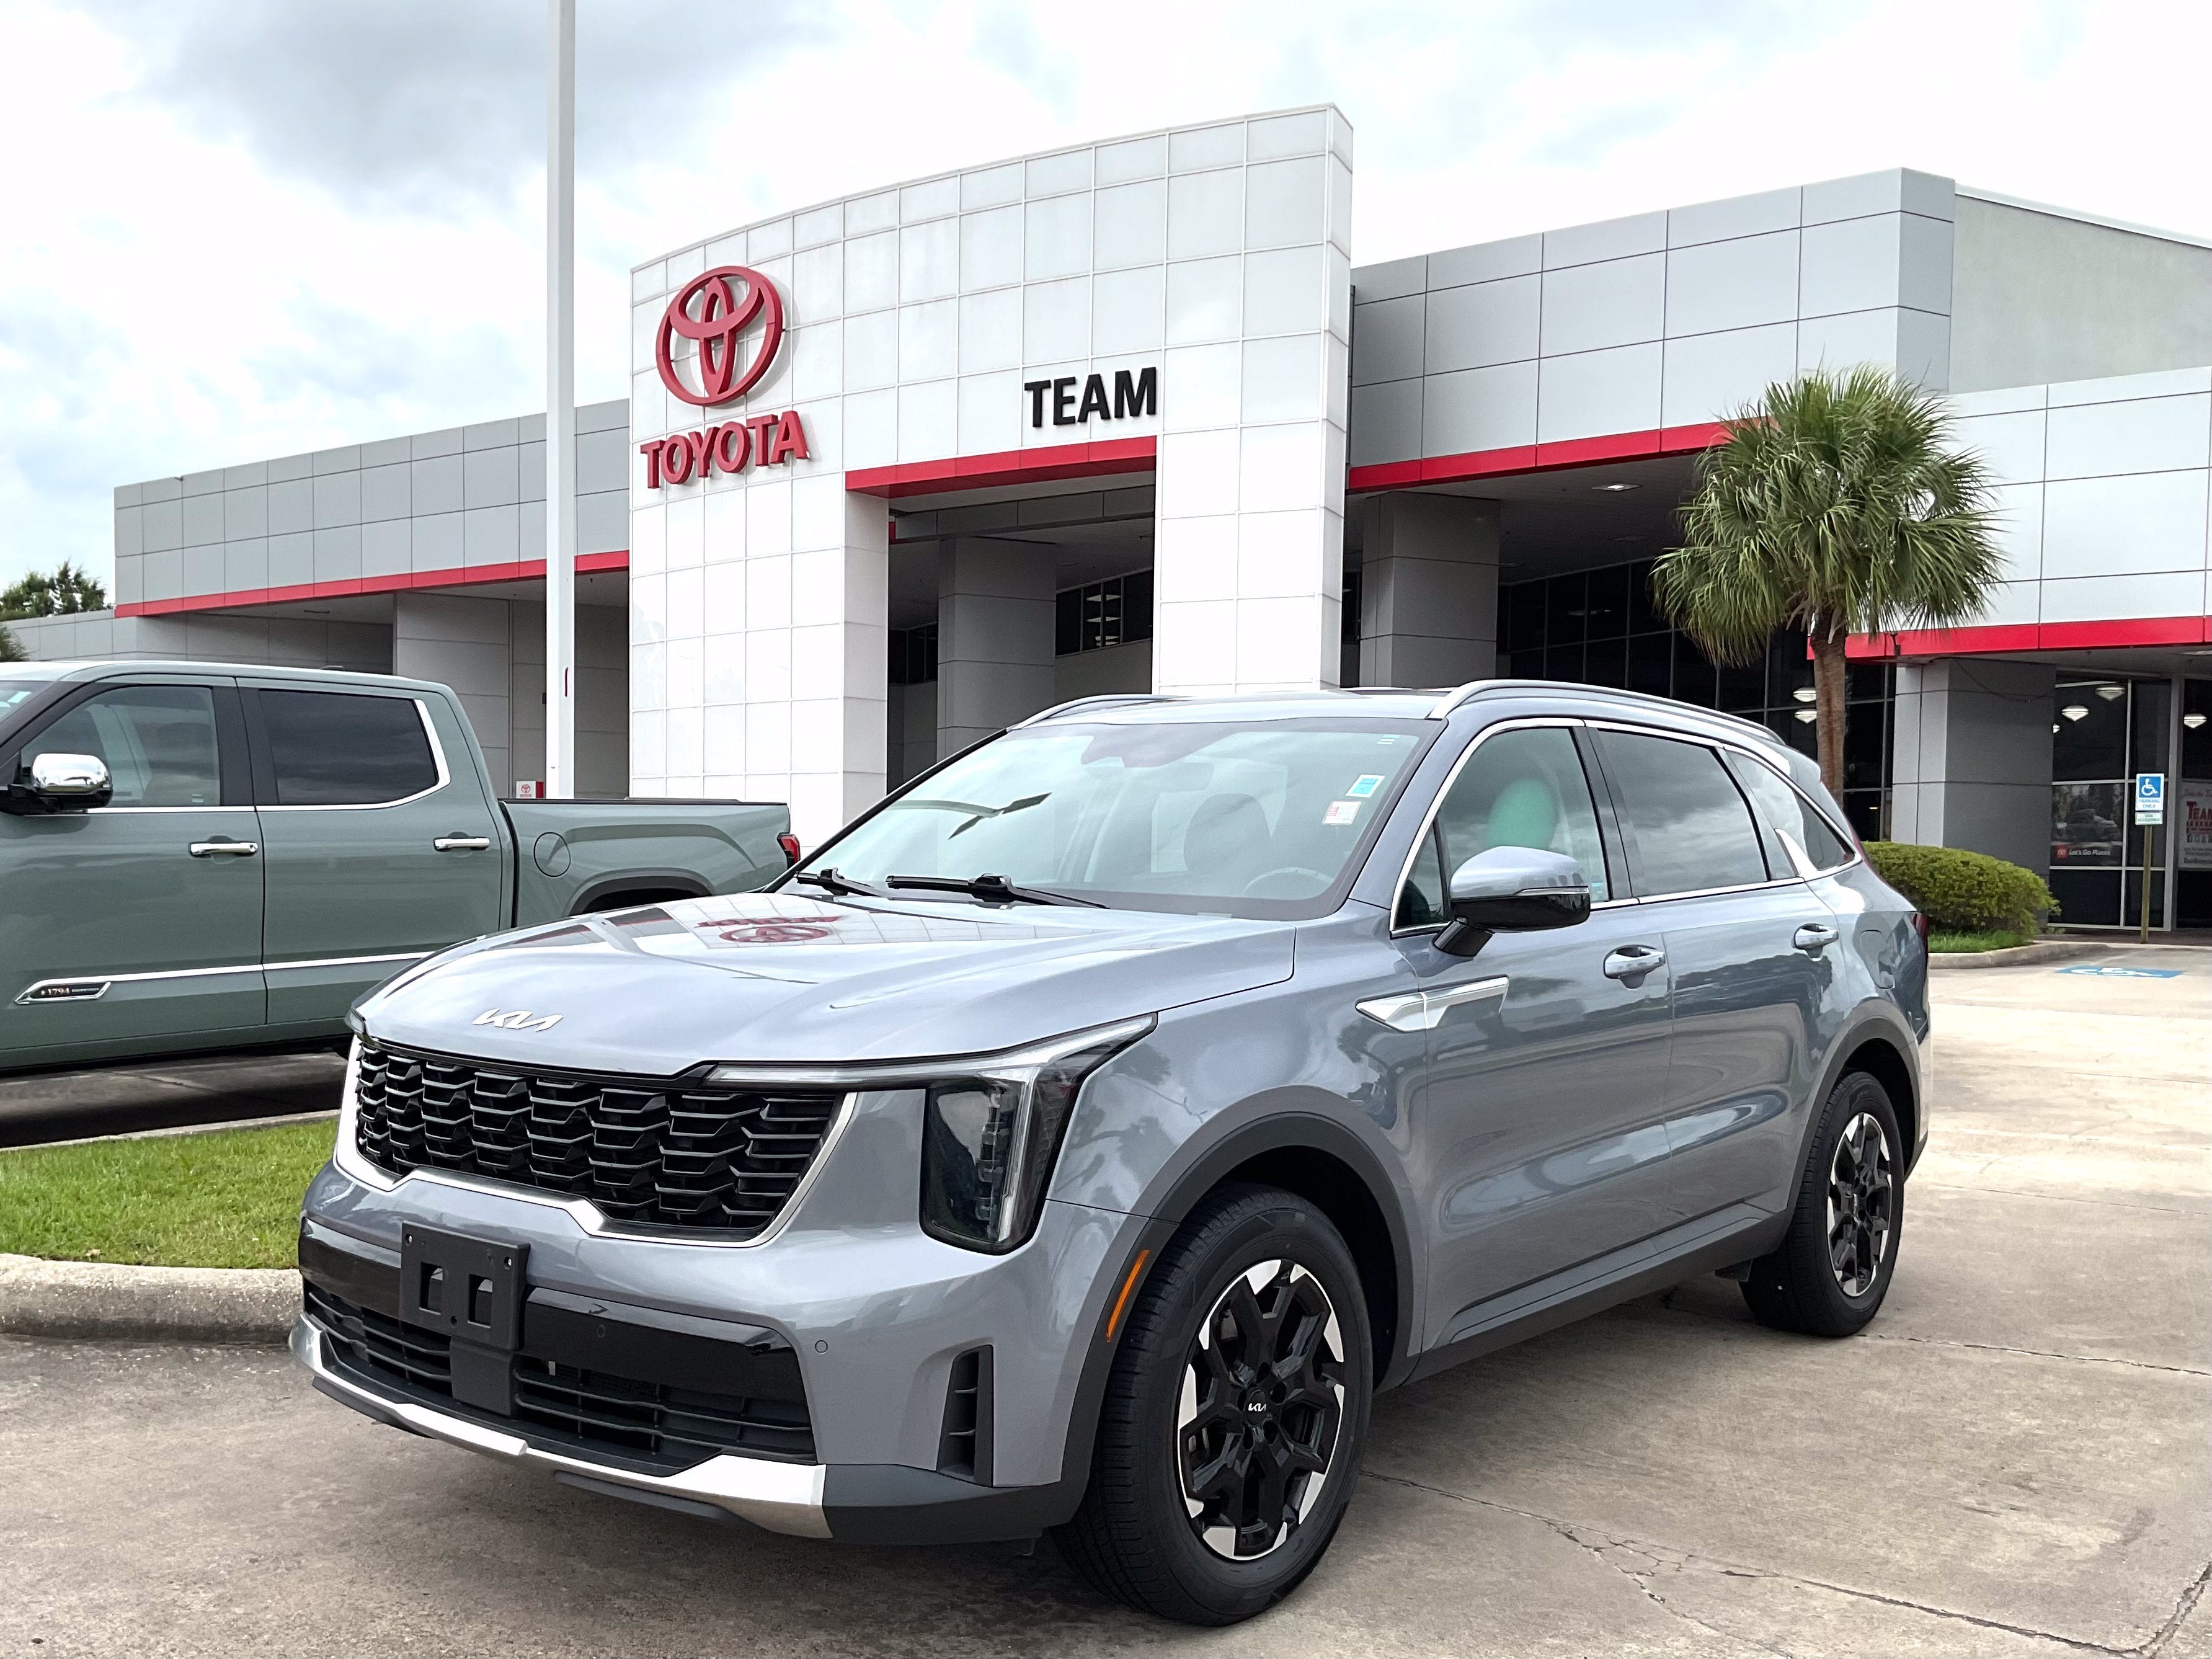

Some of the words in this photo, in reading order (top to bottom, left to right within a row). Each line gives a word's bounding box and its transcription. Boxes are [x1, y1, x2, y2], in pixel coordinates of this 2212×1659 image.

[1024, 367, 1156, 427] TEAM
[640, 410, 809, 489] TOYOTA
[47, 987, 70, 996] 1794
[472, 1008, 564, 1032] KIA
[1248, 1402, 1267, 1412] KIA
